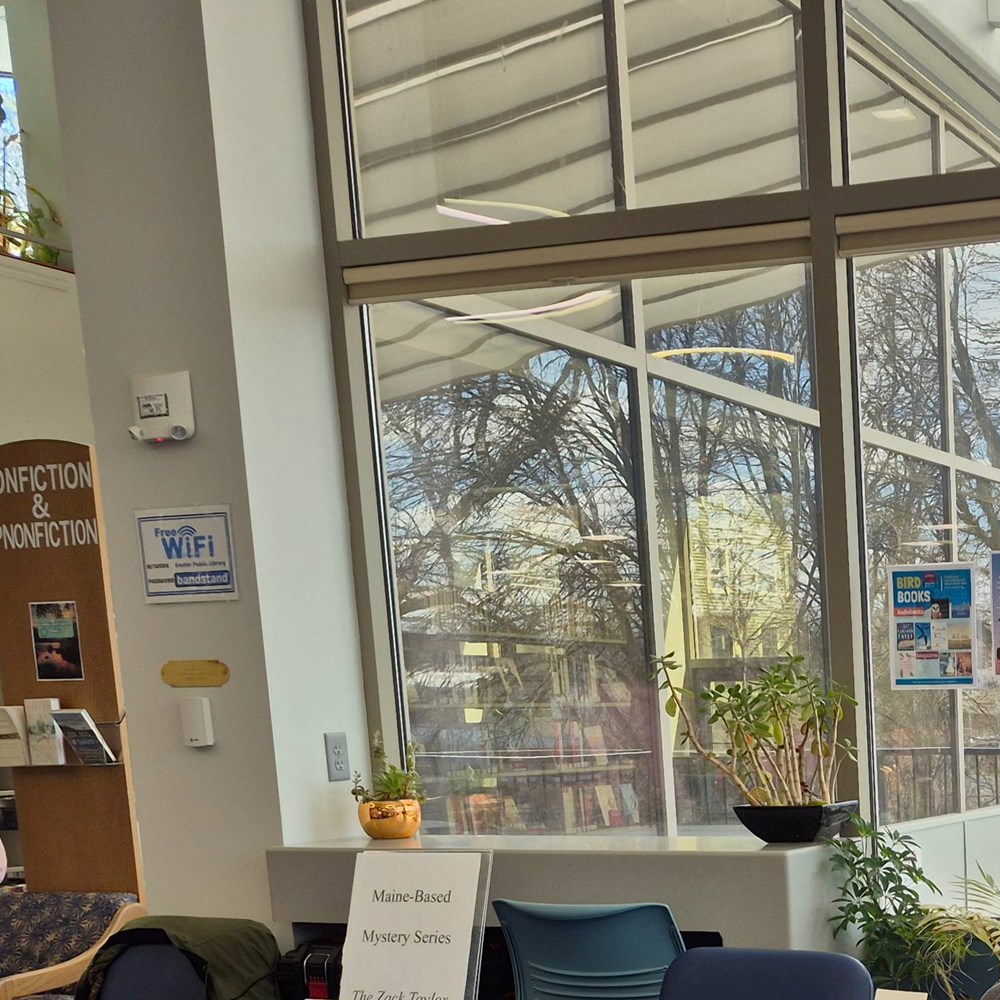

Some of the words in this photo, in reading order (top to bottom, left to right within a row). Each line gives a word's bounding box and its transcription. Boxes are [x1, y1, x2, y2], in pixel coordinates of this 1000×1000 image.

[32, 493, 51, 519] &
[154, 528, 177, 537] Free
[161, 535, 214, 559] WiFi
[176, 572, 229, 584] bandstand
[897, 577, 920, 588] BIRD
[897, 590, 931, 603] BOOKS
[372, 889, 452, 903] Maine-Based
[362, 930, 410, 946] Mystery
[414, 930, 451, 944] Series
